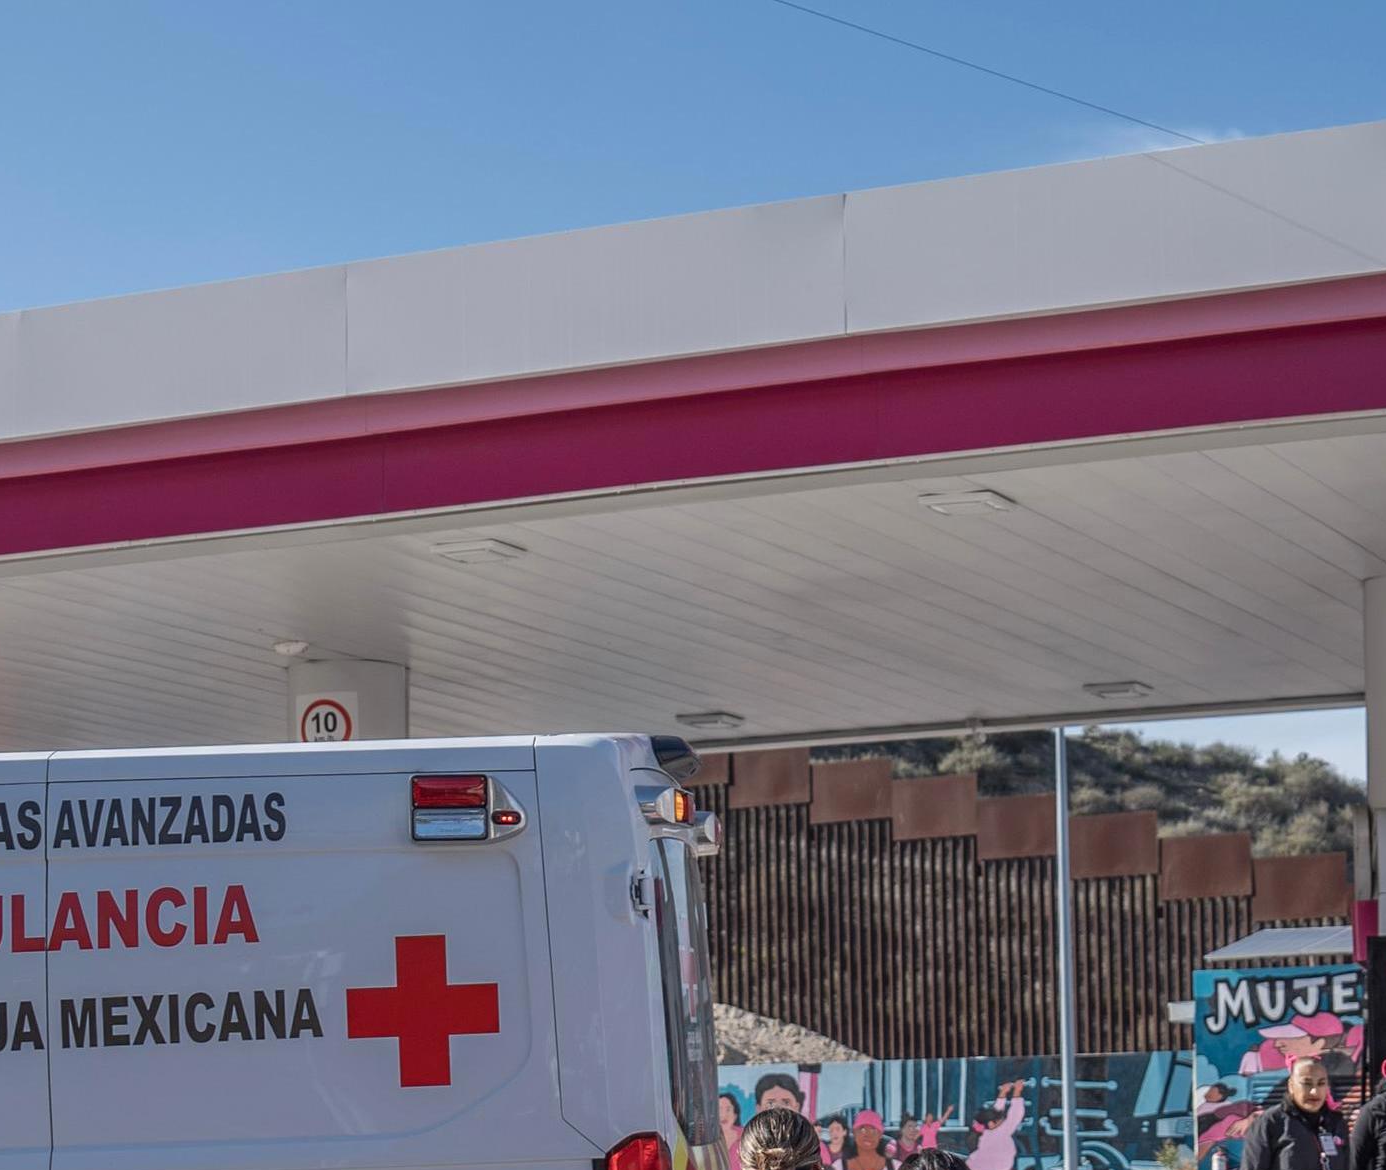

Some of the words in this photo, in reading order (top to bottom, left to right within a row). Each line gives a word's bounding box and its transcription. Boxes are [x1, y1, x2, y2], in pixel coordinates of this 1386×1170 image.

[312, 711, 338, 734] 10
[53, 792, 287, 849] AVANZADAS
[60, 988, 324, 1049] MEXICANA
[1205, 972, 1361, 1034] MUJE
